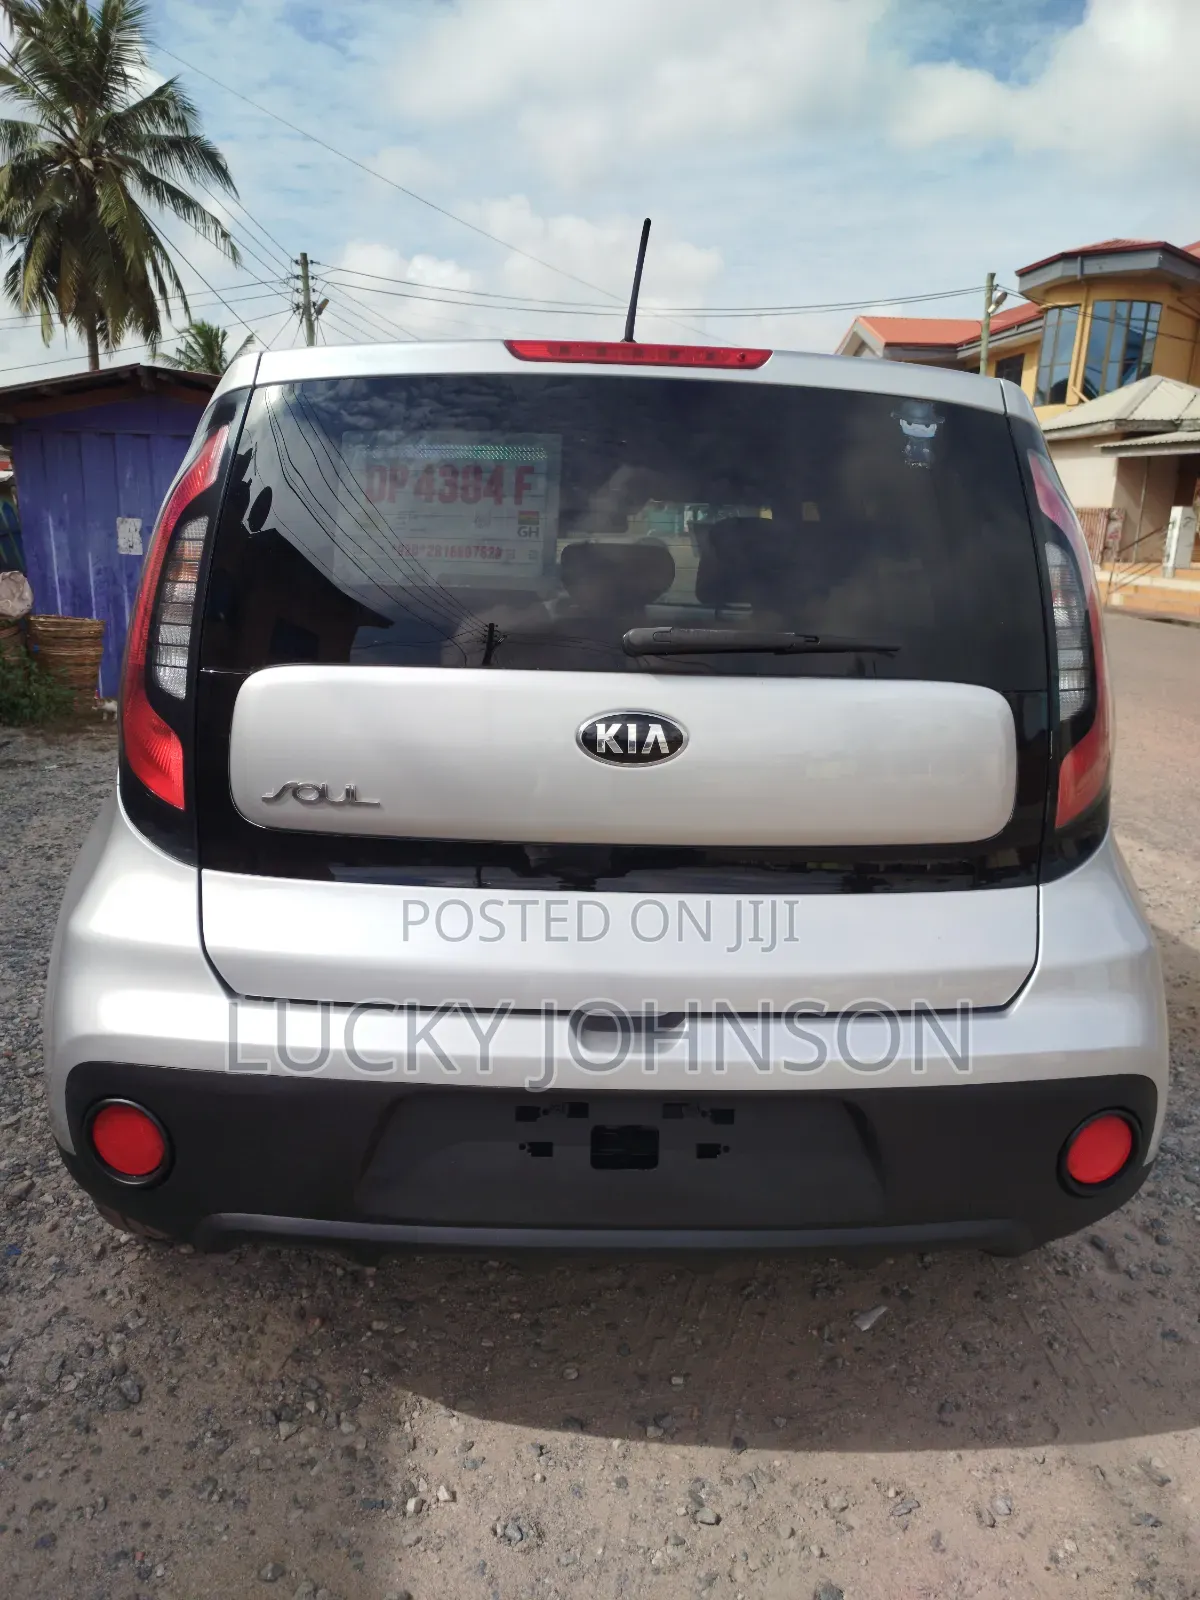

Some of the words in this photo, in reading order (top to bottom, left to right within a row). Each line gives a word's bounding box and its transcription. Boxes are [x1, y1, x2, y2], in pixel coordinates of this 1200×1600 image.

[513, 465, 535, 506] F
[517, 525, 540, 539] GH
[595, 722, 671, 755] KIA
[261, 780, 381, 807] SOUL
